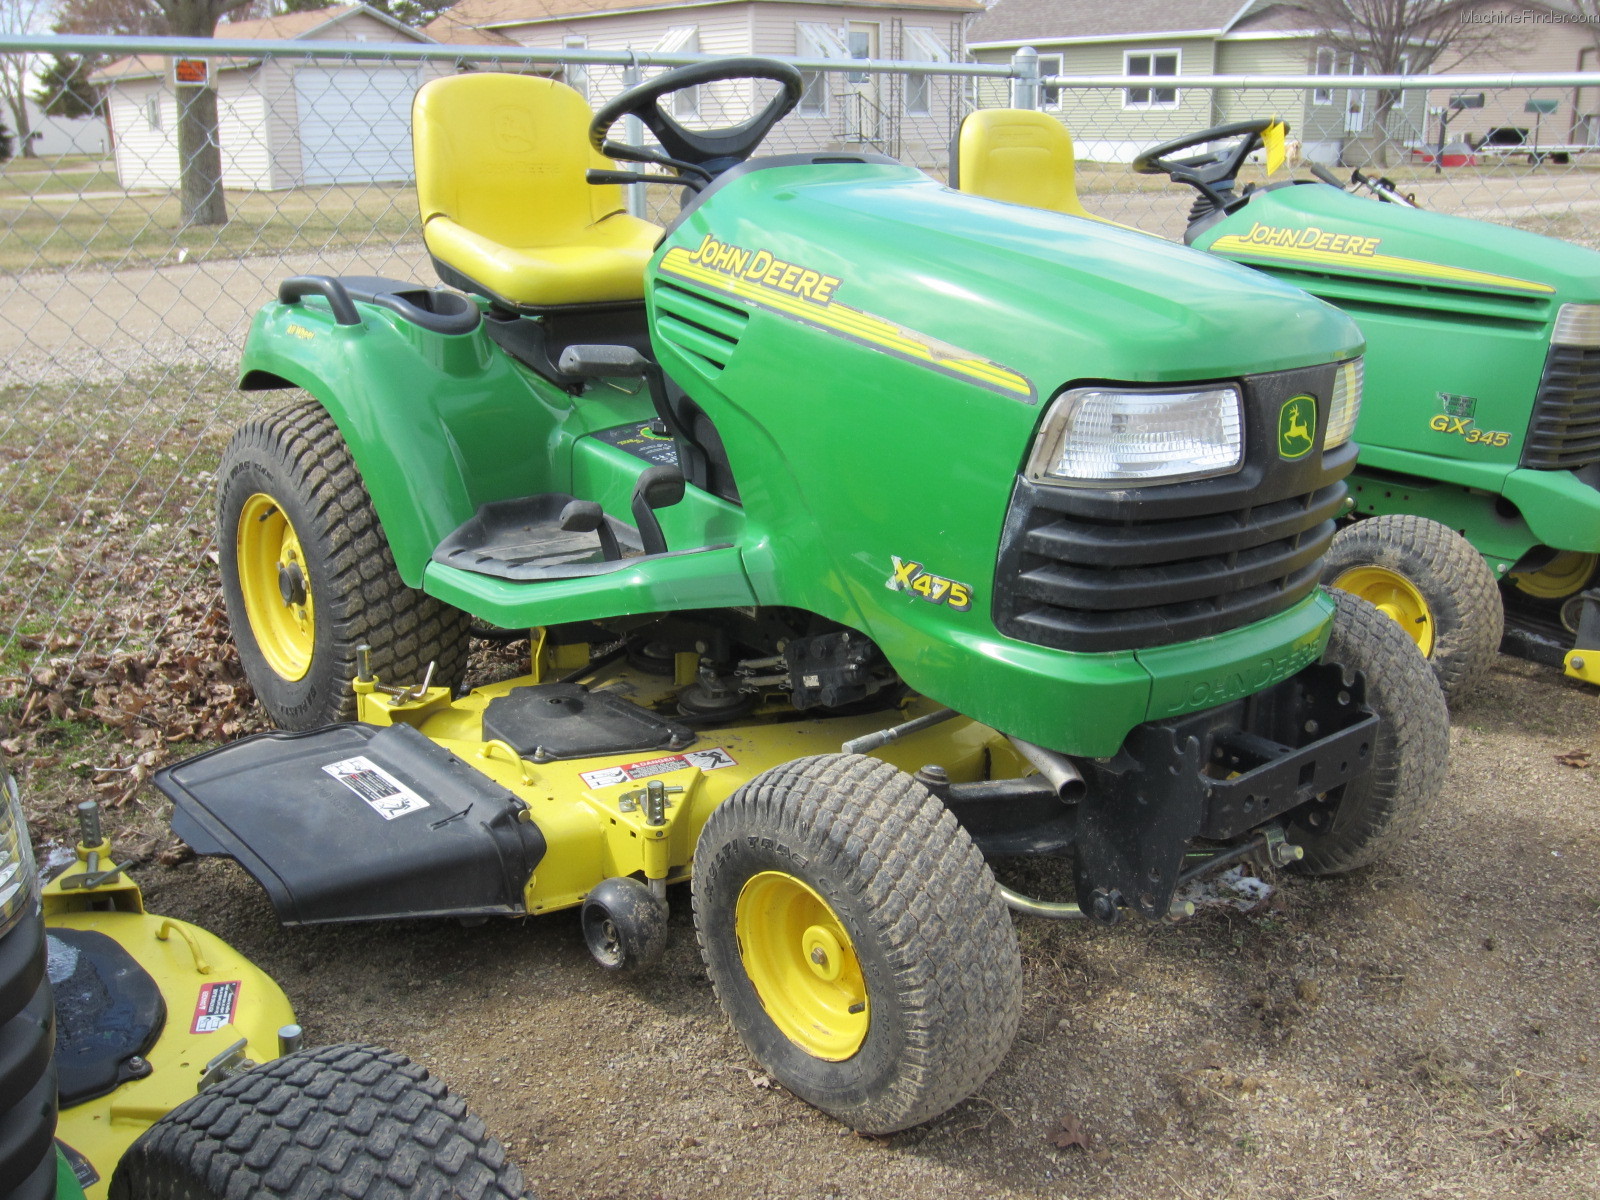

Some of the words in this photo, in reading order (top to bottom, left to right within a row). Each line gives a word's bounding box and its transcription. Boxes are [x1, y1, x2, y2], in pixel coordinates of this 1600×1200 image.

[1239, 221, 1300, 248] JOHN
[1298, 226, 1382, 257] DEERE
[689, 233, 752, 278] JOHN
[744, 249, 843, 305] DEERE
[1167, 670, 1249, 712] JOHN
[1253, 639, 1320, 688] DEERE
[638, 756, 676, 767] DANGER
[747, 836, 809, 869] TRAC
